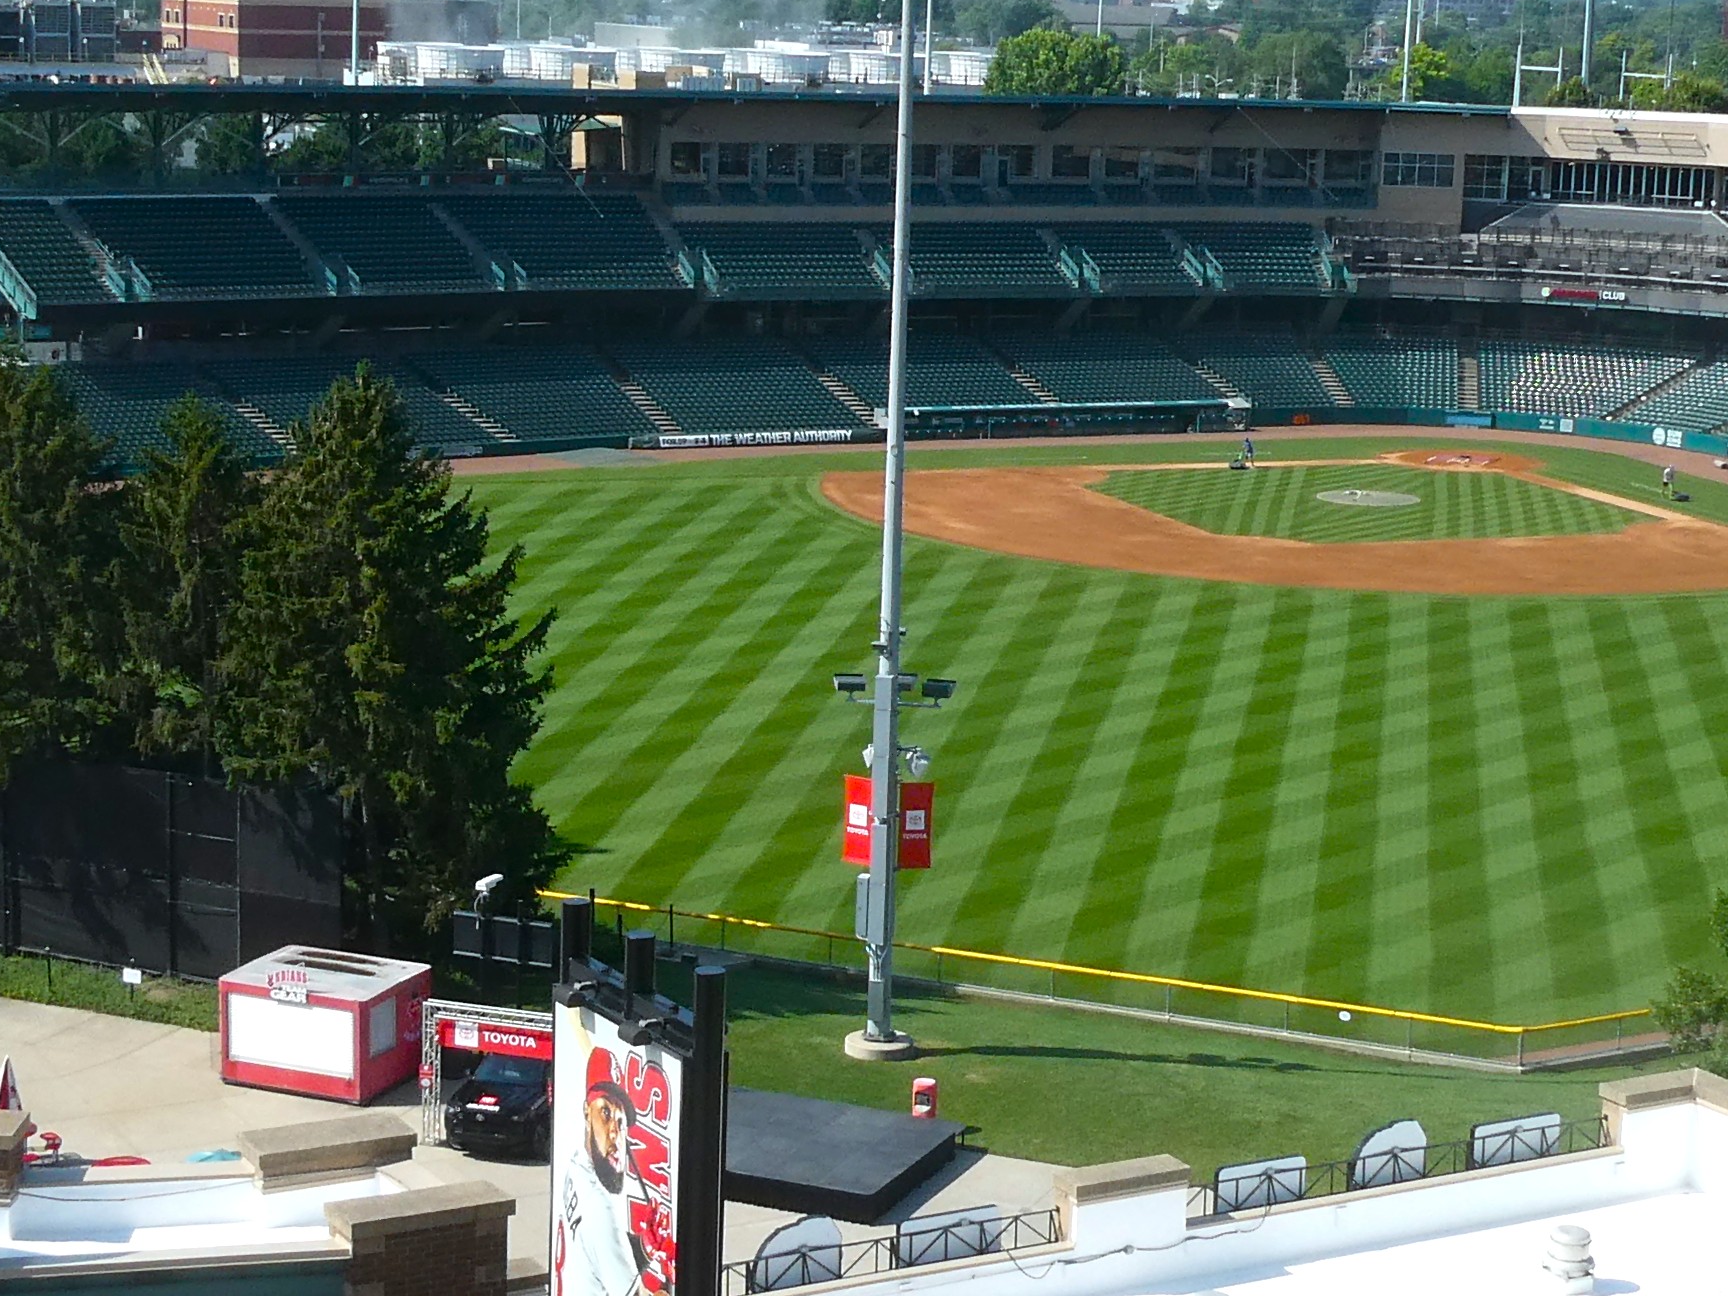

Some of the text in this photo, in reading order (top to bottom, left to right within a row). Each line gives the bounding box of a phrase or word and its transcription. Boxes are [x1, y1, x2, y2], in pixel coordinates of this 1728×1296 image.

[1602, 290, 1625, 301] CLUB
[709, 433, 732, 446] THE
[734, 431, 792, 445] WEATHER
[793, 429, 852, 443] AUTHORITY
[846, 826, 870, 836] TOYOTA
[902, 832, 928, 840] TOYOTA
[269, 989, 308, 1003] GEAR
[482, 1030, 537, 1049] TOYOTA
